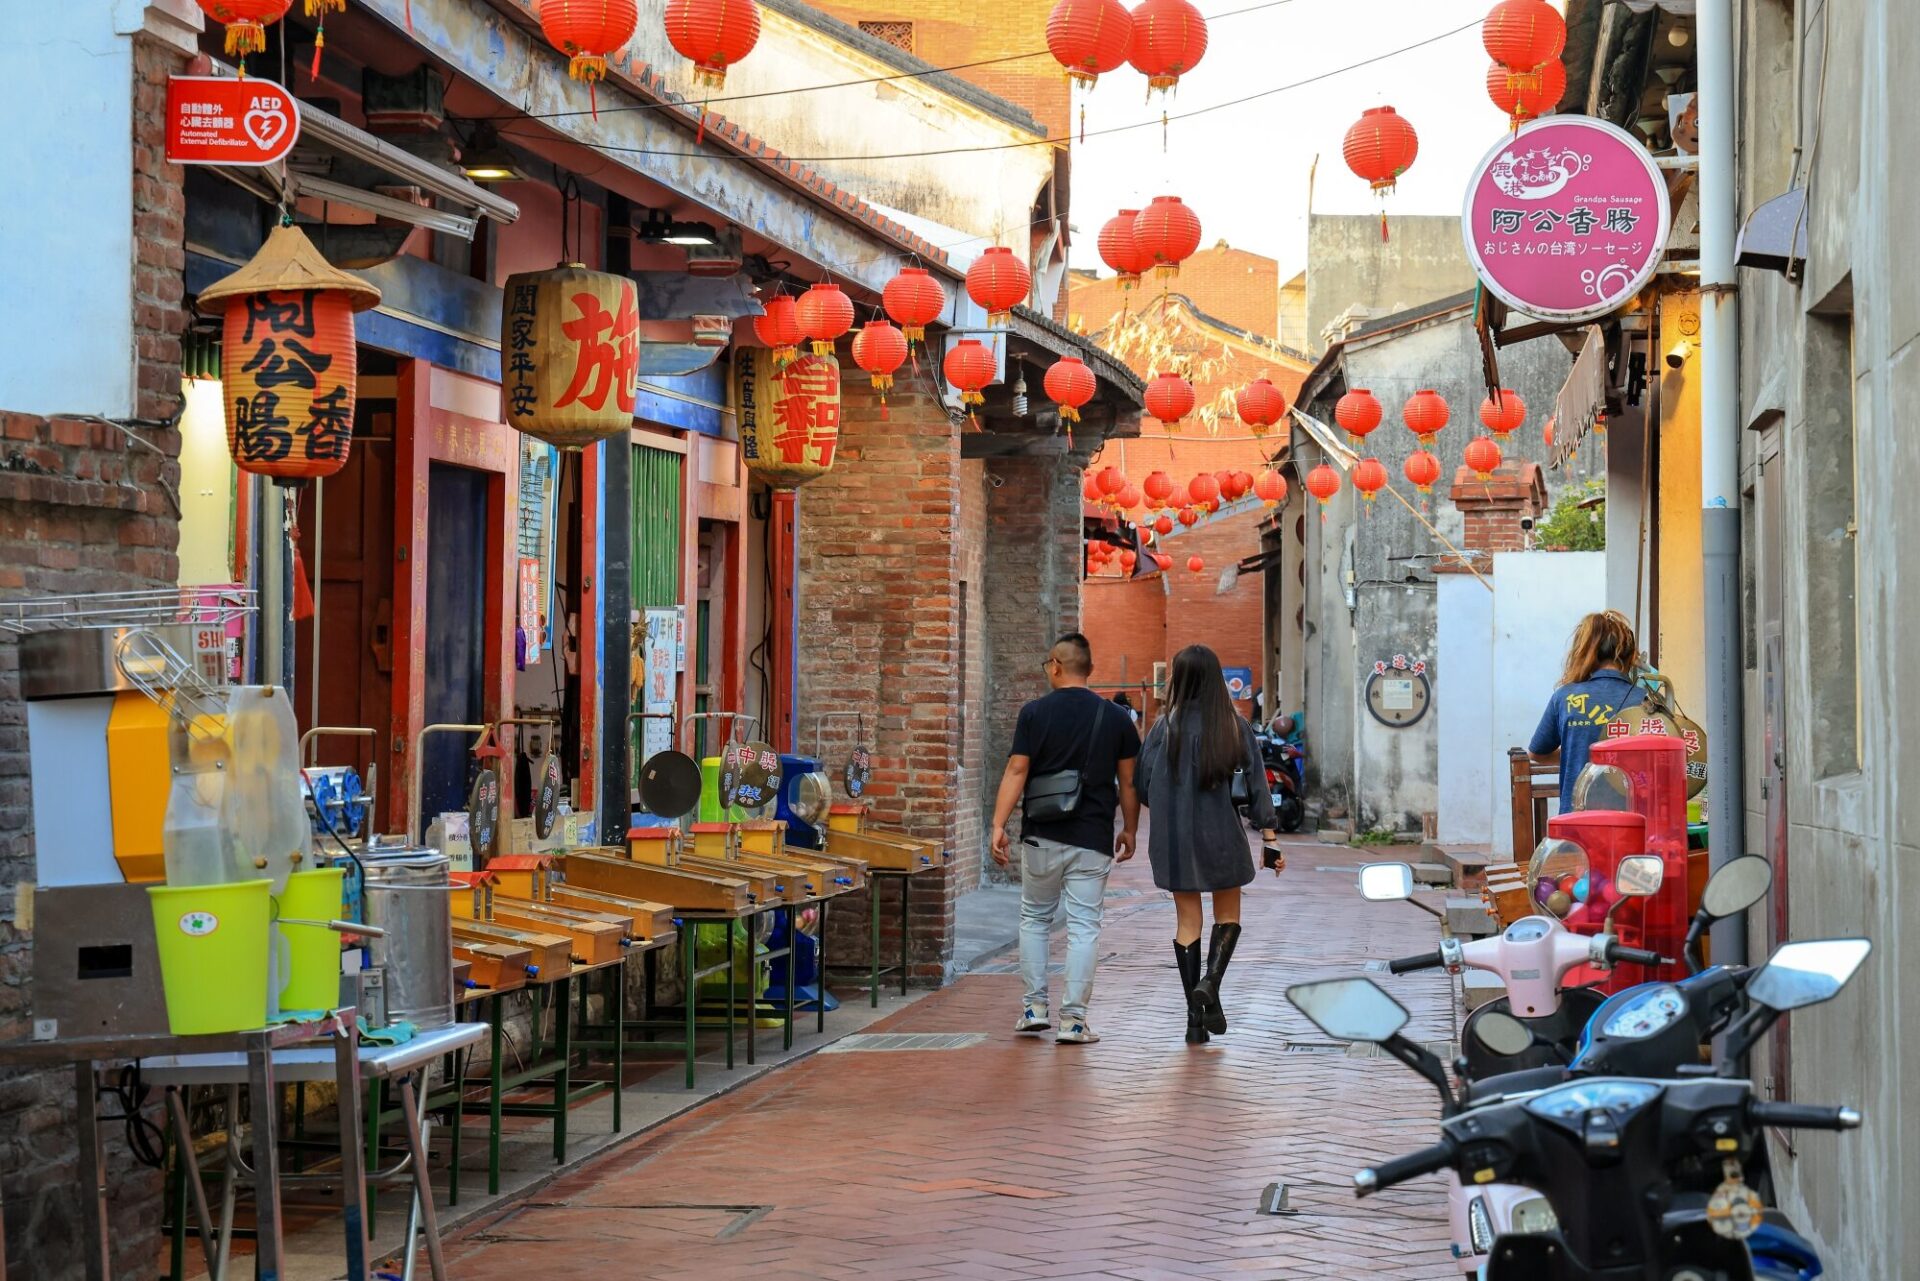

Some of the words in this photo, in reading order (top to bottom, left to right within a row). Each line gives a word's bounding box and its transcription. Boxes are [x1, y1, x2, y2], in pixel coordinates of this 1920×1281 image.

[180, 103, 223, 115] 自動體外
[250, 96, 282, 109] AED
[180, 130, 218, 138] Automated
[209, 139, 248, 147] Defibrillator
[1490, 161, 1526, 197] 鹿港
[1574, 195, 1607, 204] Grandpa
[1610, 195, 1643, 204] Sausage
[1491, 206, 1640, 237] 阿公香腸
[1483, 240, 1643, 256] おじさんの台湾ソーセージ
[1566, 693, 1613, 725] 阿公
[739, 746, 779, 772] 中獎
